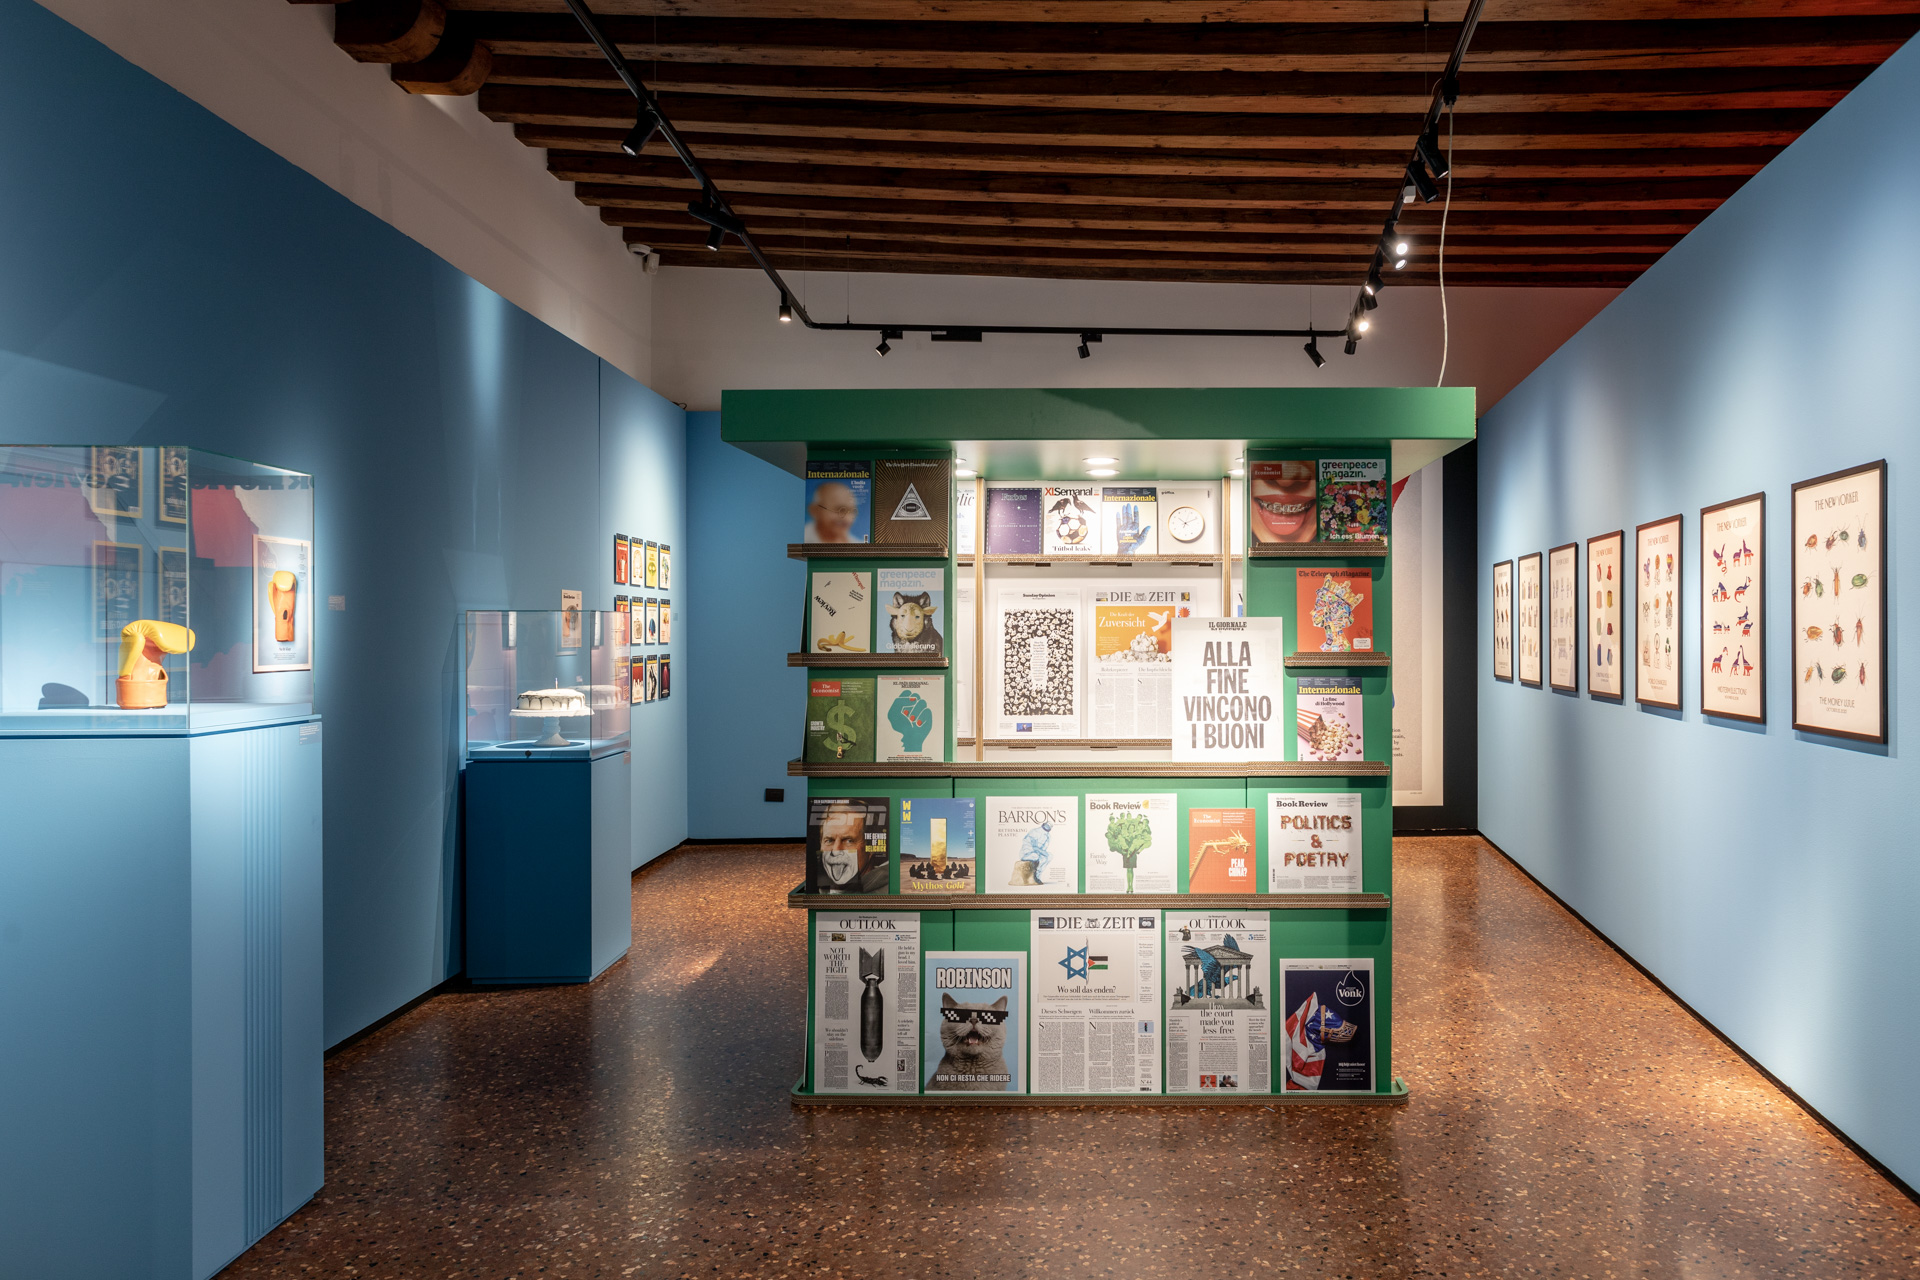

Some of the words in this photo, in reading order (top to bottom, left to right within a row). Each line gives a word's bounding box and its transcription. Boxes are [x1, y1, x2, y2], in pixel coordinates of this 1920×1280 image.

[1322, 460, 1378, 470] greenpeace
[808, 470, 870, 478] Internazionale
[1322, 470, 1366, 479] magazin.
[1000, 492, 1028, 501] Forbes
[1814, 498, 1824, 510] THE
[1824, 496, 1838, 508] NEW
[1837, 490, 1859, 506] YORKER
[880, 570, 936, 580] greenpeace
[880, 580, 924, 589] magazin.
[1110, 592, 1132, 602] DIE
[1148, 592, 1176, 602] ZEIT
[814, 595, 837, 617] Review
[1099, 616, 1145, 628] Zuversicht
[1203, 641, 1252, 667] ALLA
[1207, 668, 1249, 694] FINE
[1299, 686, 1361, 694] Internazionale
[1819, 696, 1827, 705] THE
[1828, 697, 1843, 706] MONEY
[1183, 695, 1272, 721] VINCONO
[1191, 724, 1197, 749] I
[1204, 723, 1264, 749] BUONI
[903, 801, 911, 810] W
[1090, 801, 1111, 810] Book
[1113, 801, 1141, 810] Review
[809, 805, 887, 826] ESPN
[903, 812, 911, 822] W
[999, 810, 1066, 824] BARRON'S
[1281, 815, 1352, 830] POLITICS
[1310, 834, 1322, 848] &
[1231, 858, 1245, 867] PEAK
[1284, 852, 1349, 867] POETRY
[912, 881, 944, 892] Mythos
[946, 881, 965, 890] Gold
[840, 919, 896, 929] OUTLOOK
[1056, 917, 1082, 929] DIE
[1103, 917, 1135, 929] ZEIT
[1189, 919, 1246, 929] OUTLOOK
[936, 967, 1012, 988] ROBINSON
[1339, 989, 1362, 998] Vonk
